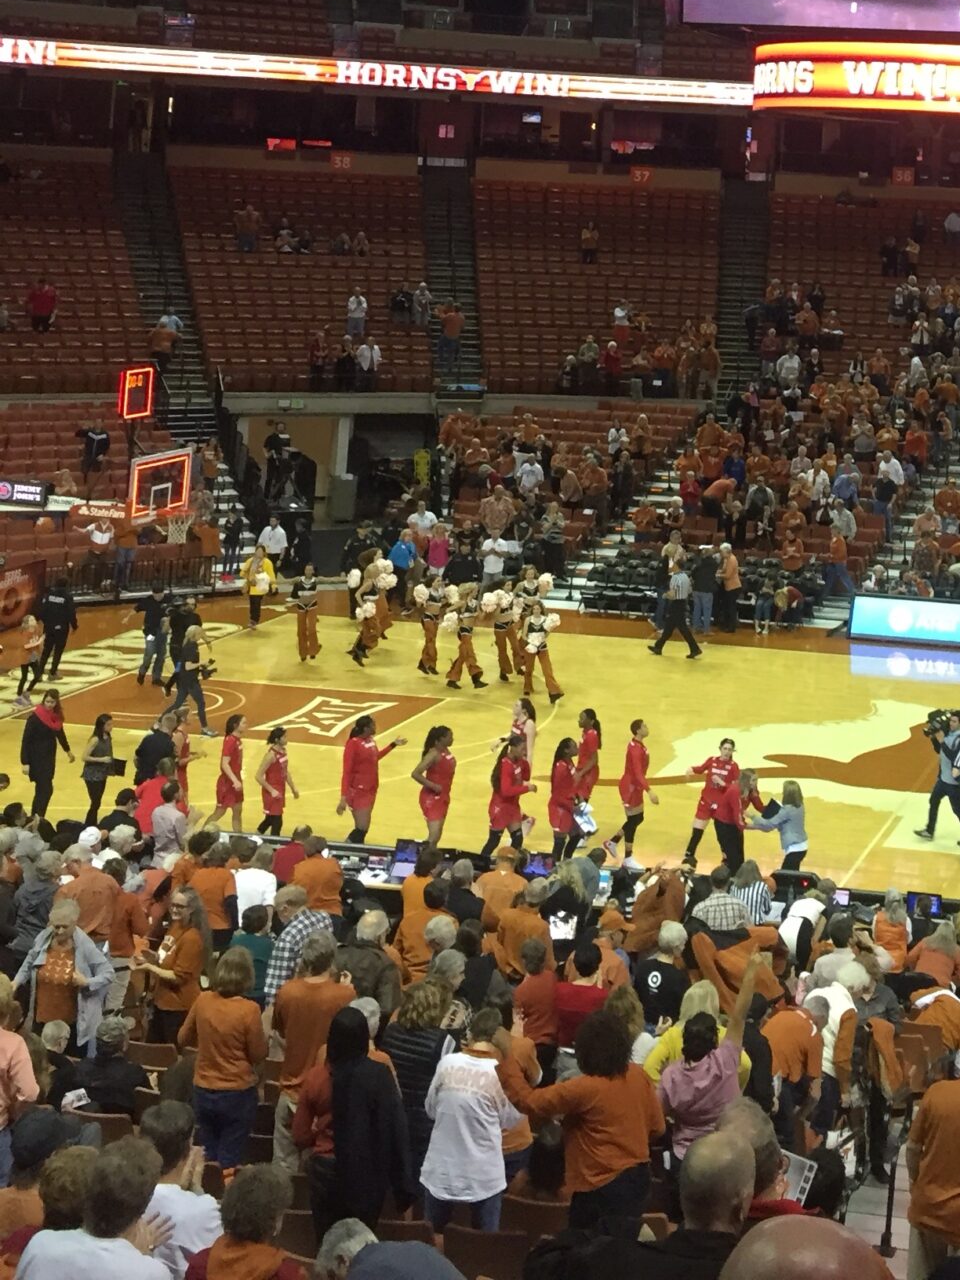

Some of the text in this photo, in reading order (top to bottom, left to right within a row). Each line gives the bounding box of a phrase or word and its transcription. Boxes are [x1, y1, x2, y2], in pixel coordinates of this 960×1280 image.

[335, 60, 571, 97] HORNS WIN!
[843, 62, 947, 99] WIN!
[333, 156, 351, 169] 38
[633, 170, 651, 182] 37
[14, 484, 42, 494] JIMMY
